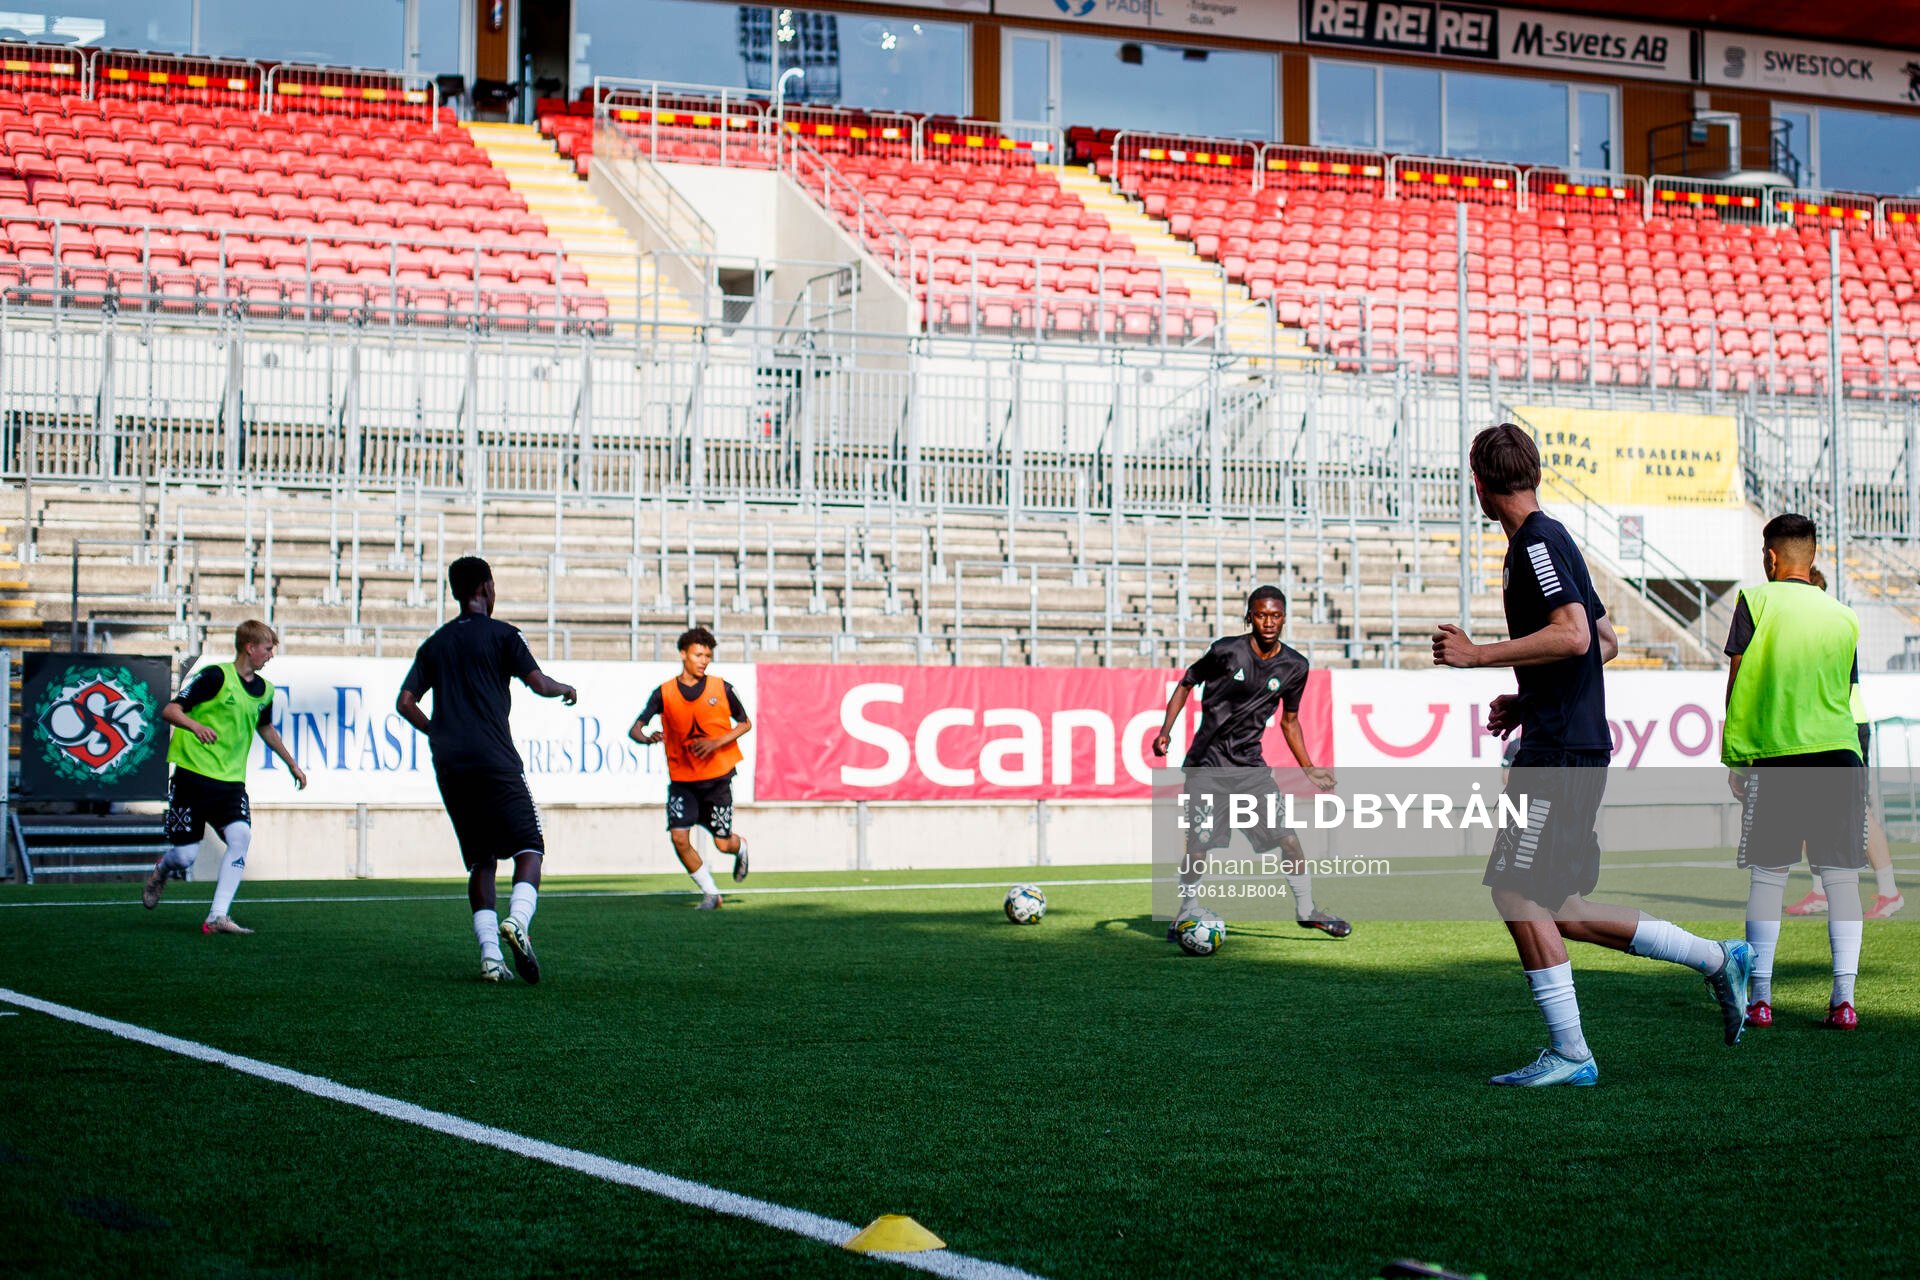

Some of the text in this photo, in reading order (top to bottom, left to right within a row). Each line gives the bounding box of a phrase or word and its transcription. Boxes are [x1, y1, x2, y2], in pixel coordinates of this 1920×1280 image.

[1310, 1, 1492, 51] RE! RE! RE!
[1511, 21, 1669, 63] M-svets AB
[1764, 50, 1873, 81] SWESTOCK
[1545, 431, 1591, 450] ERRA
[1646, 464, 1695, 477] KEBAB
